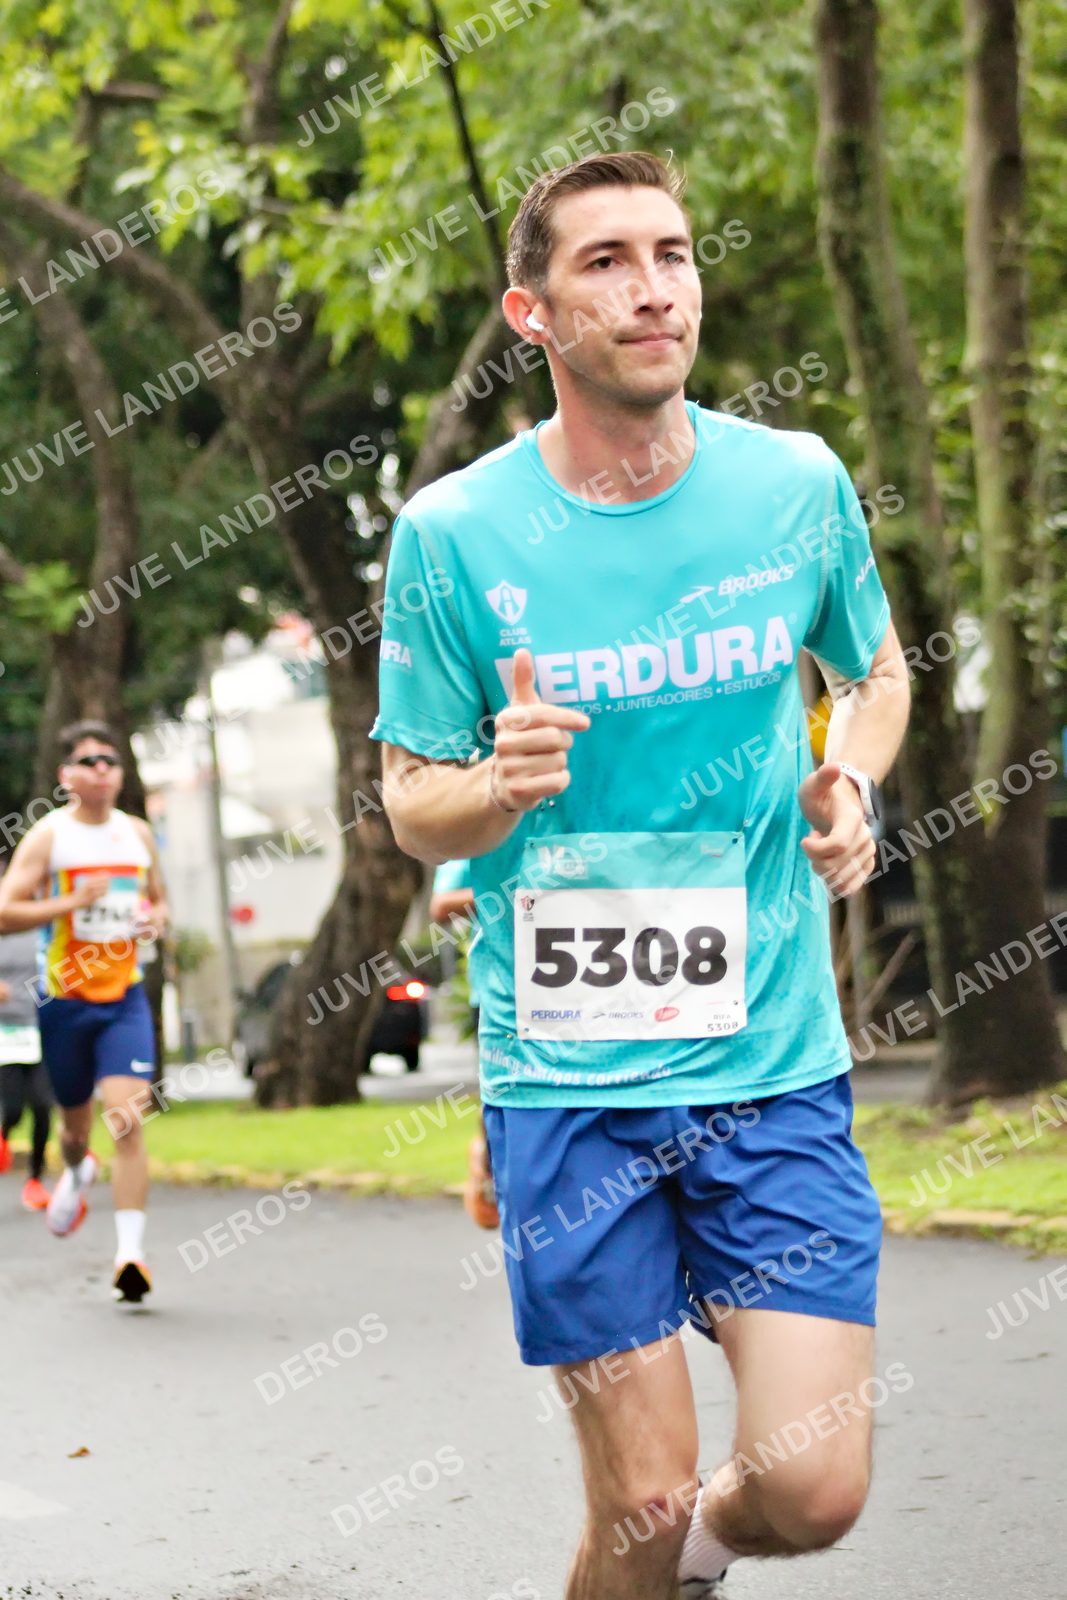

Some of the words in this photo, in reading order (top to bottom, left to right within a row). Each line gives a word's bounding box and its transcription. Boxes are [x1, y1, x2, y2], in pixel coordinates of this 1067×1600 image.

[718, 562, 795, 597] BROOKS
[499, 627, 528, 637] CLUB
[500, 634, 532, 647] ATLAS
[612, 686, 714, 714] JUNTEADORES
[723, 671, 782, 696] ESTUCOS
[530, 925, 728, 988] 5308
[531, 1010, 582, 1020] PERDURA
[707, 1021, 739, 1032] 5308
